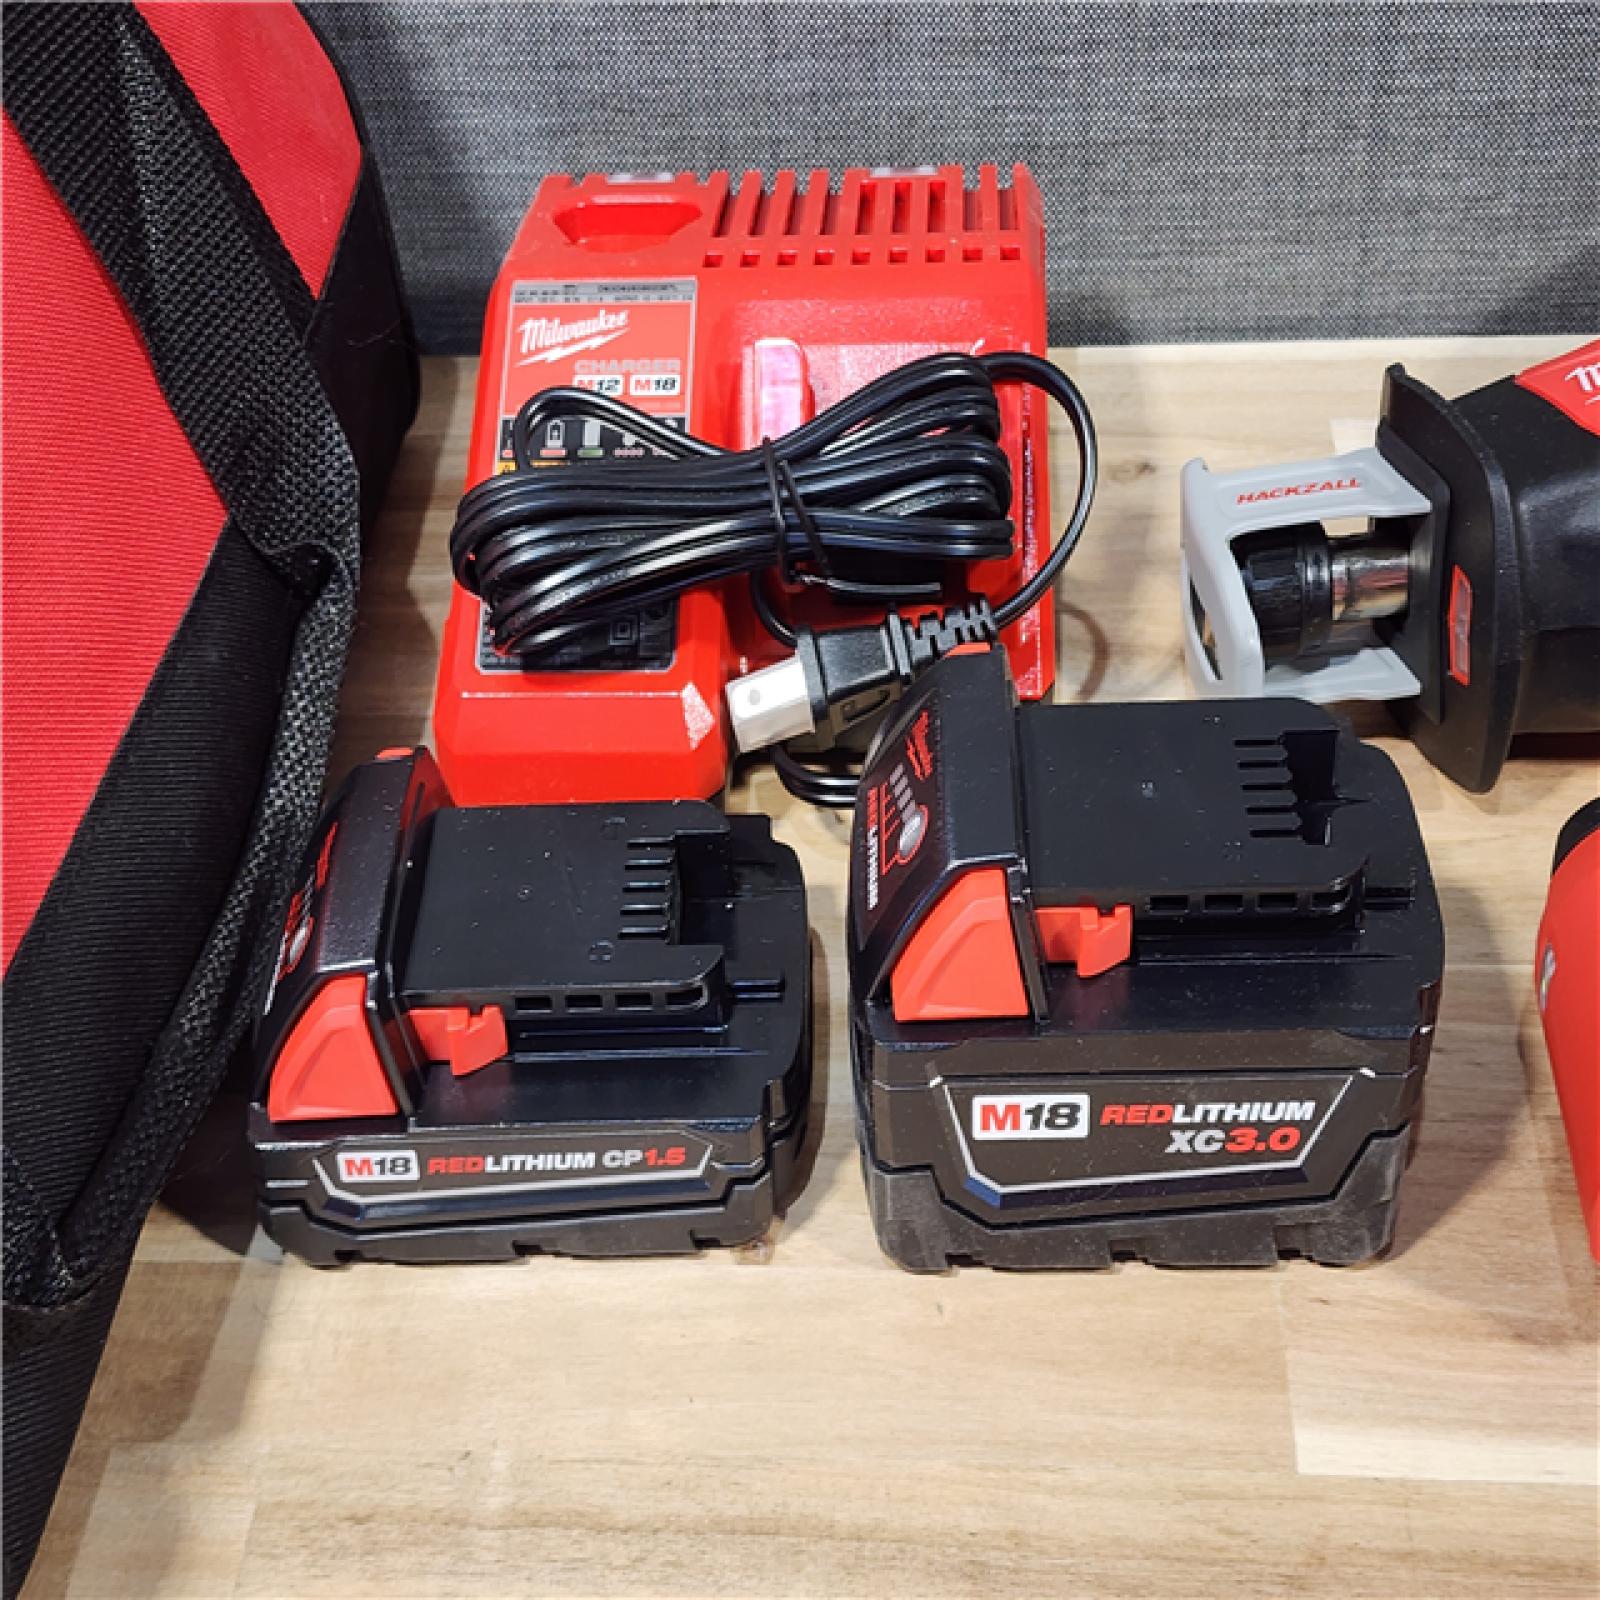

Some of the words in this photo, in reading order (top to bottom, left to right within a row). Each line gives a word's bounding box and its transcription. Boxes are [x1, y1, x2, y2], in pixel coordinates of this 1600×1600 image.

[518, 309, 630, 354] Milwaukee
[574, 359, 681, 375] CHARGER
[634, 377, 678, 392] M18
[1235, 477, 1361, 505] HACKZALL
[978, 1100, 1081, 1133] M18
[1099, 1100, 1316, 1126] REDLITHIUM
[1165, 1126, 1301, 1154] XC3.0
[344, 1154, 412, 1177] M18
[427, 1151, 596, 1175] REDLITHIUM
[602, 1146, 687, 1169] CP1.5
